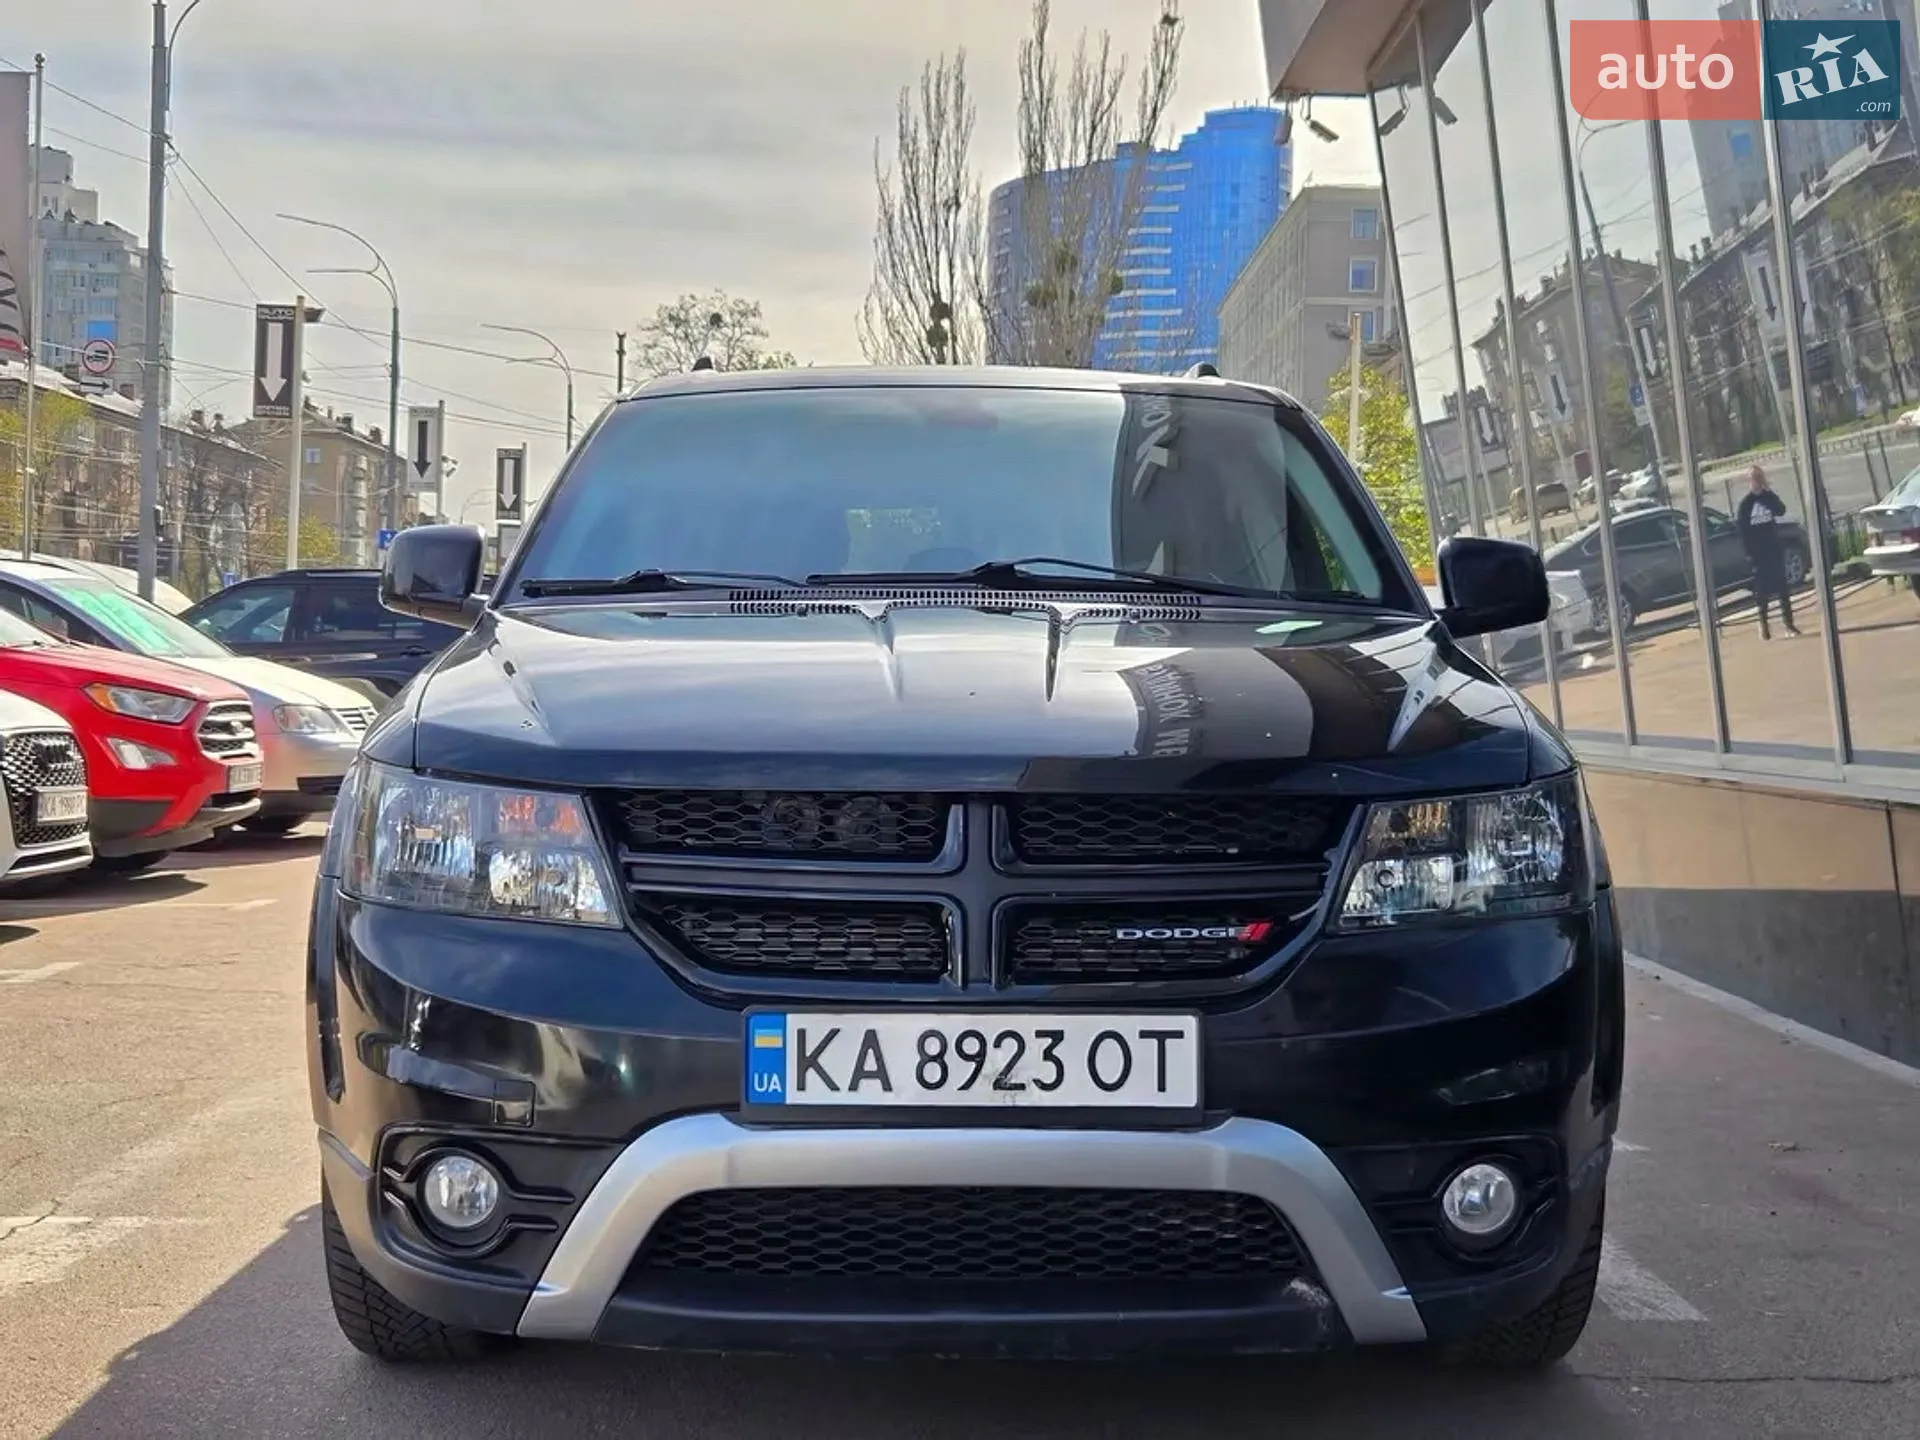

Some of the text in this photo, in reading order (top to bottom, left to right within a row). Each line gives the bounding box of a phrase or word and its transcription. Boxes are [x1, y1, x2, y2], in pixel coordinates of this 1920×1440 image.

[1115, 926, 1250, 940] DODGE
[796, 1027, 1185, 1093] KA 8923 OT
[753, 1071, 783, 1093] UA
